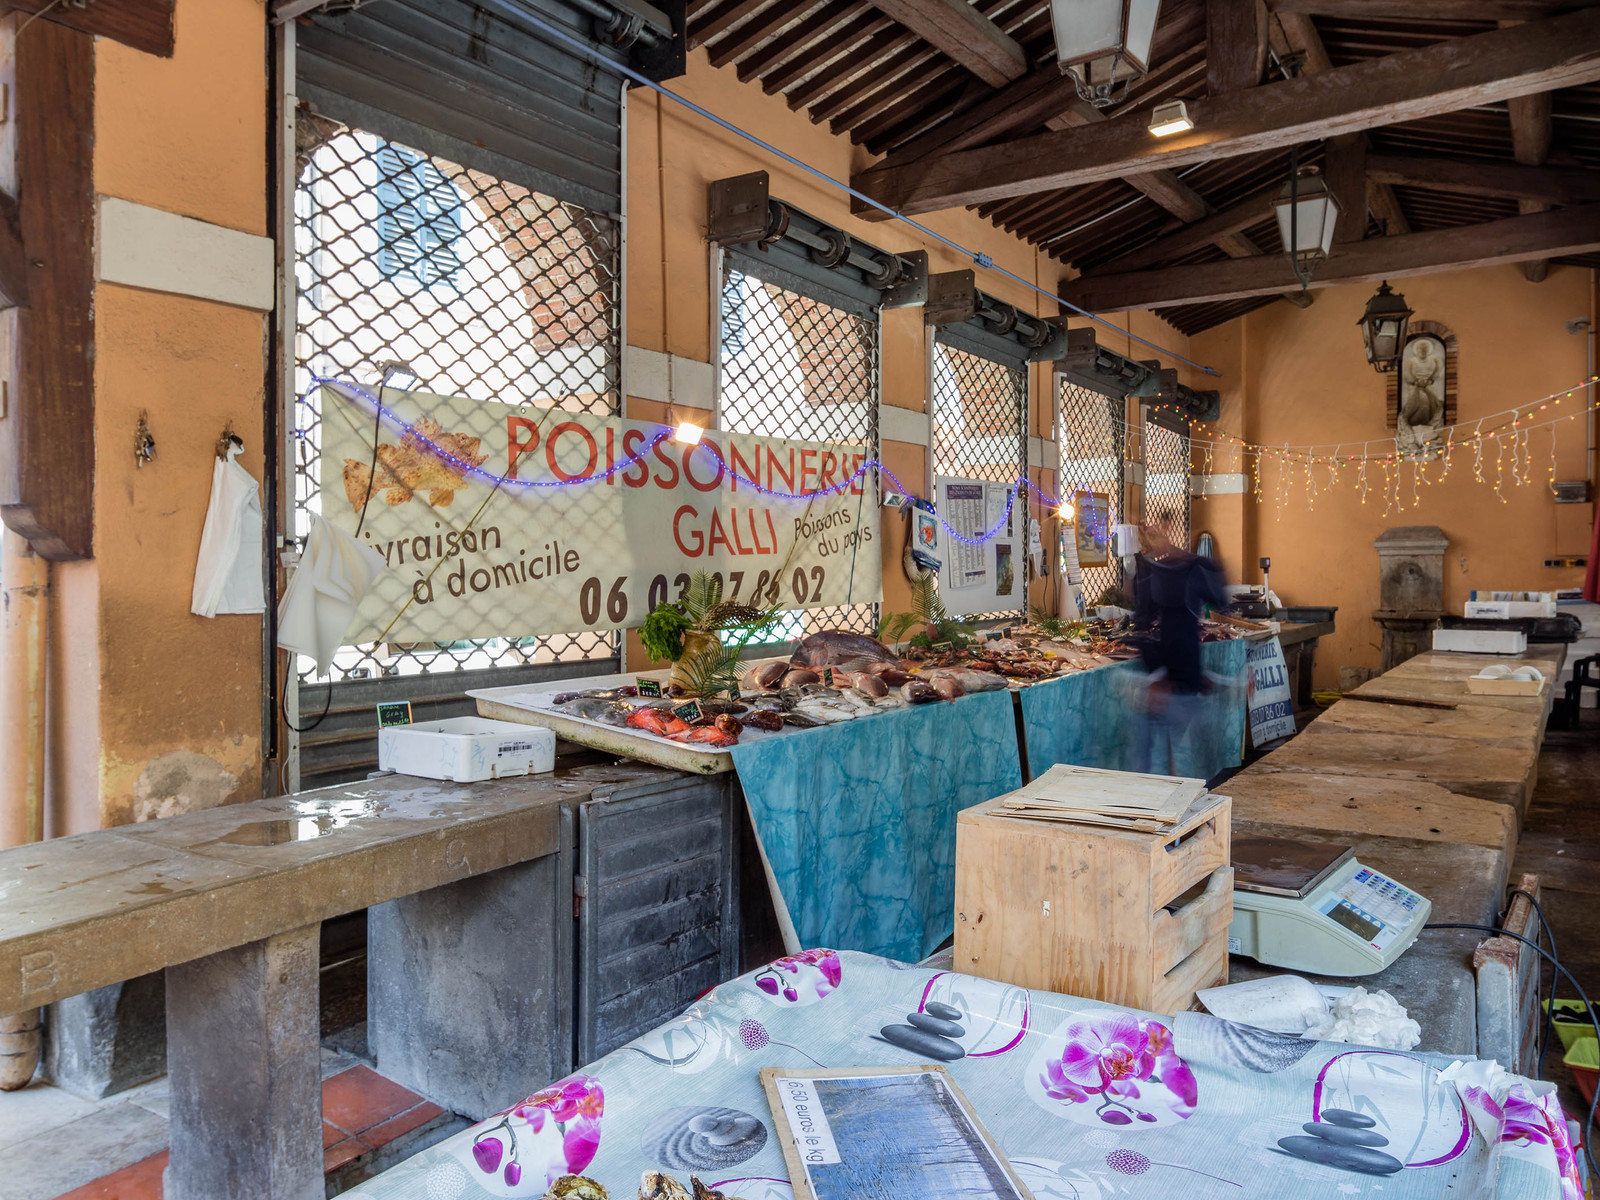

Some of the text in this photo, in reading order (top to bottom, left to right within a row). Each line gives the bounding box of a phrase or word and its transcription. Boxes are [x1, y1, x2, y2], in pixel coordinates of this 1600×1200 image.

[506, 416, 867, 496] POISSONNERIE
[672, 504, 778, 558] GALLI
[794, 509, 851, 541] Poissons
[817, 526, 873, 557] du pays
[412, 540, 581, 605] à domicile
[579, 576, 628, 626] 06
[648, 572, 692, 616] 03
[750, 568, 782, 608] 86
[792, 565, 826, 605] 02
[1254, 664, 1285, 691] GALLI
[1265, 705, 1275, 720] 86
[1275, 702, 1286, 717] 02
[1266, 719, 1287, 736] domicile
[788, 1081, 826, 1162] 6,50 euros le kg
